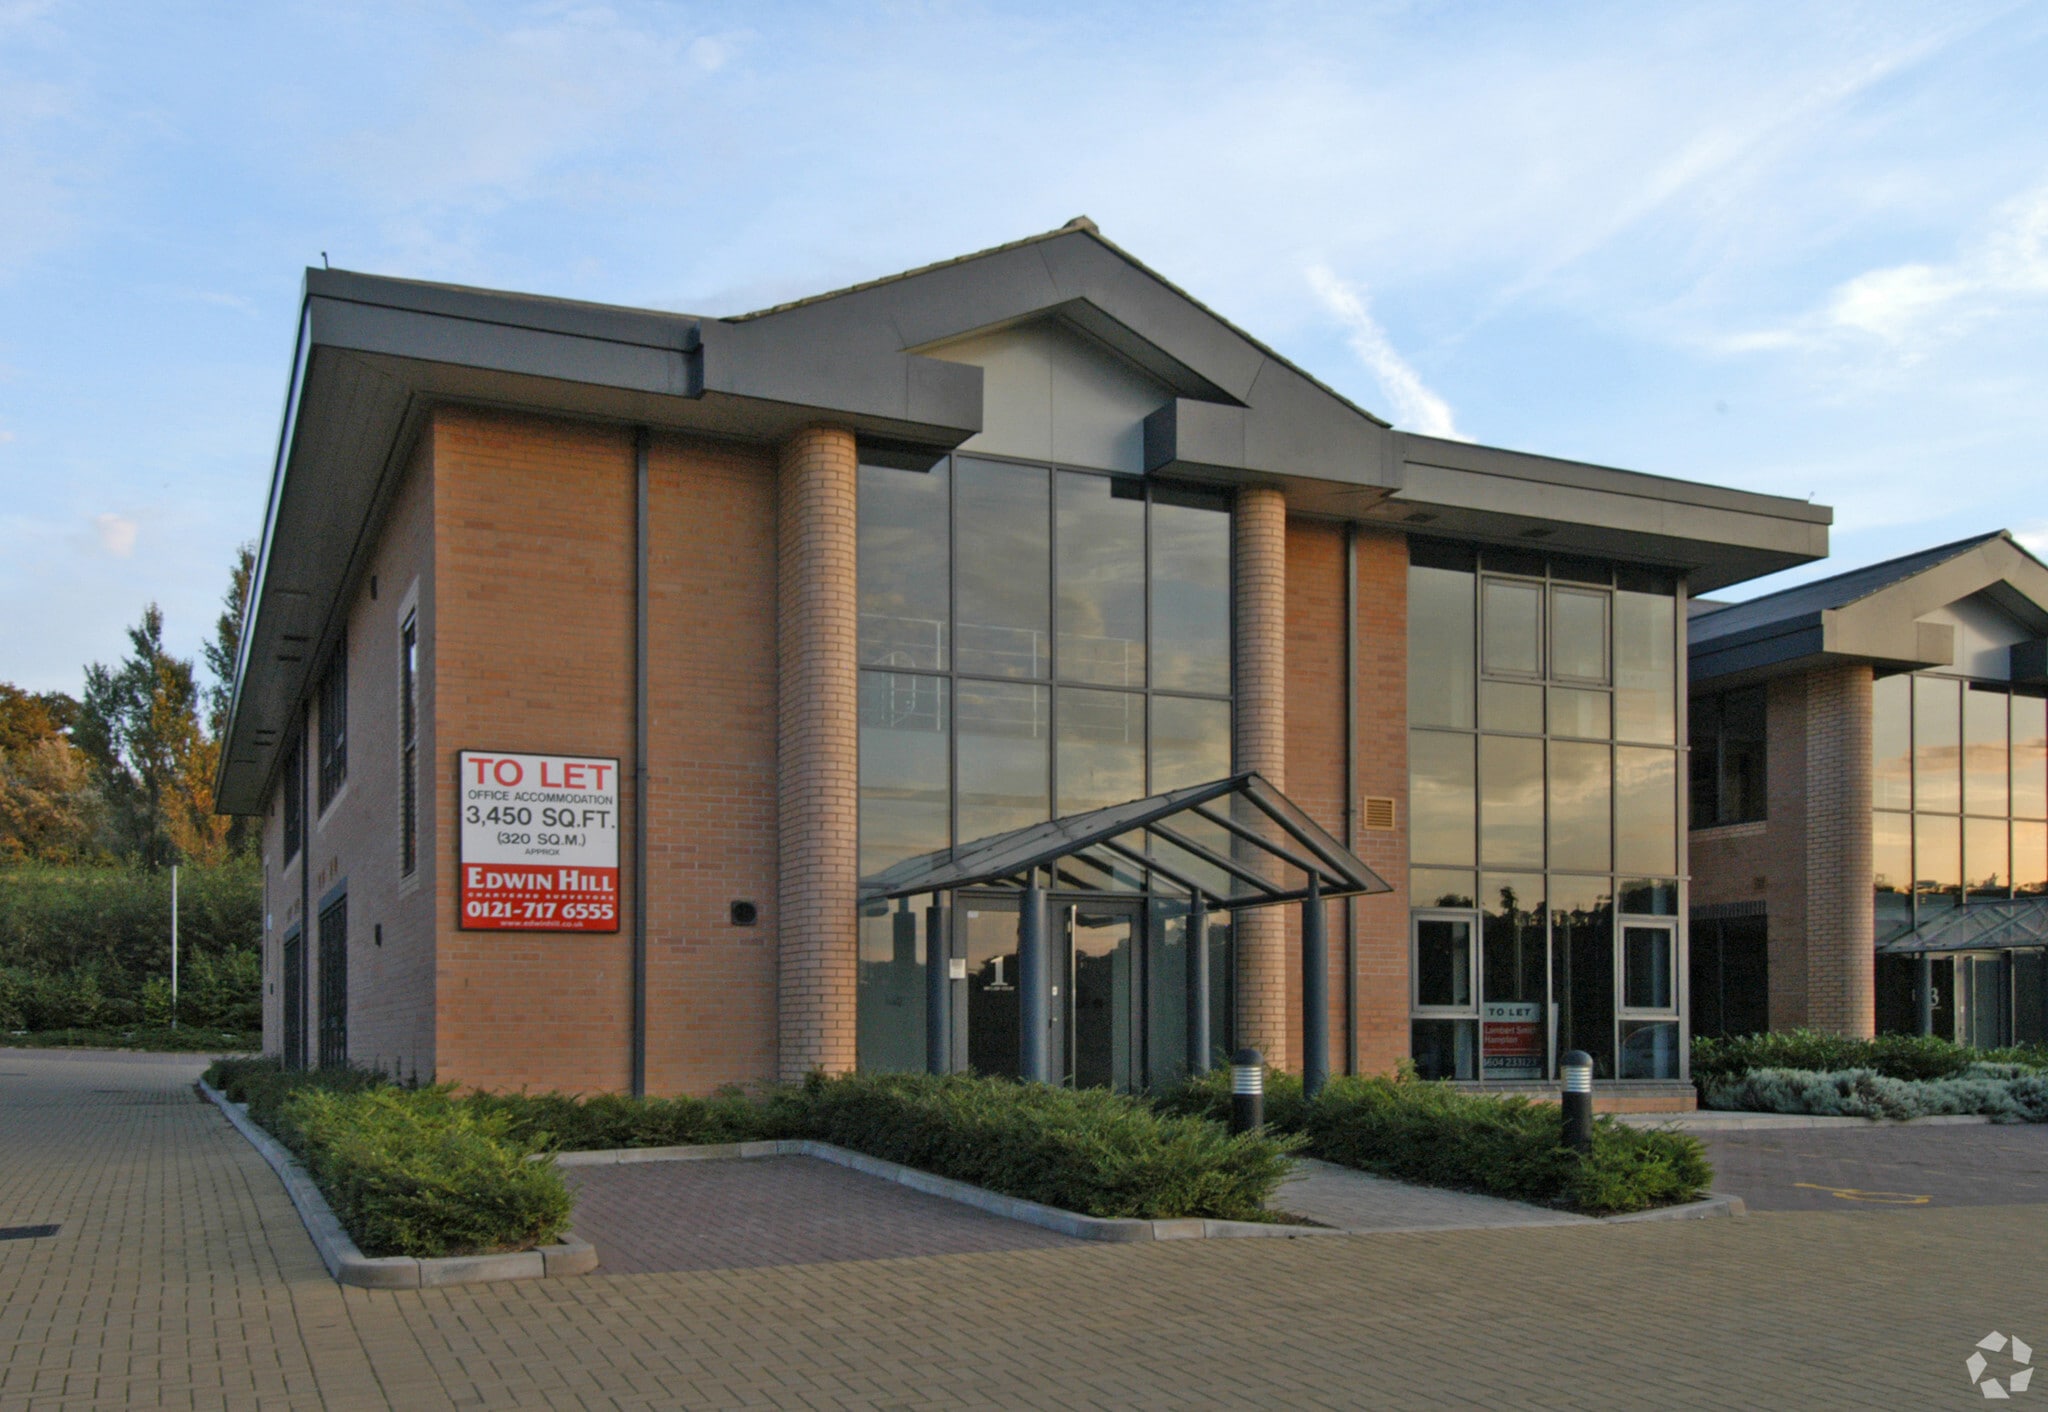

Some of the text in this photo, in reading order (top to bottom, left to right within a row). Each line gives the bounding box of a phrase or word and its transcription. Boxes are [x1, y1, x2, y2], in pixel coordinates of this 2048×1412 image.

[467, 757, 612, 791] TO LET
[468, 789, 613, 805] OFFICE ACCOMMODATION
[466, 805, 616, 829] 3,450 SQ.FT.
[497, 831, 587, 847] (320 SQ.M.)
[525, 848, 560, 856] APPROX
[467, 866, 614, 892] EDWIN HILL
[466, 900, 614, 920] 0121-717 6555
[990, 955, 1008, 985] 1
[1488, 1008, 1531, 1017] TO LET
